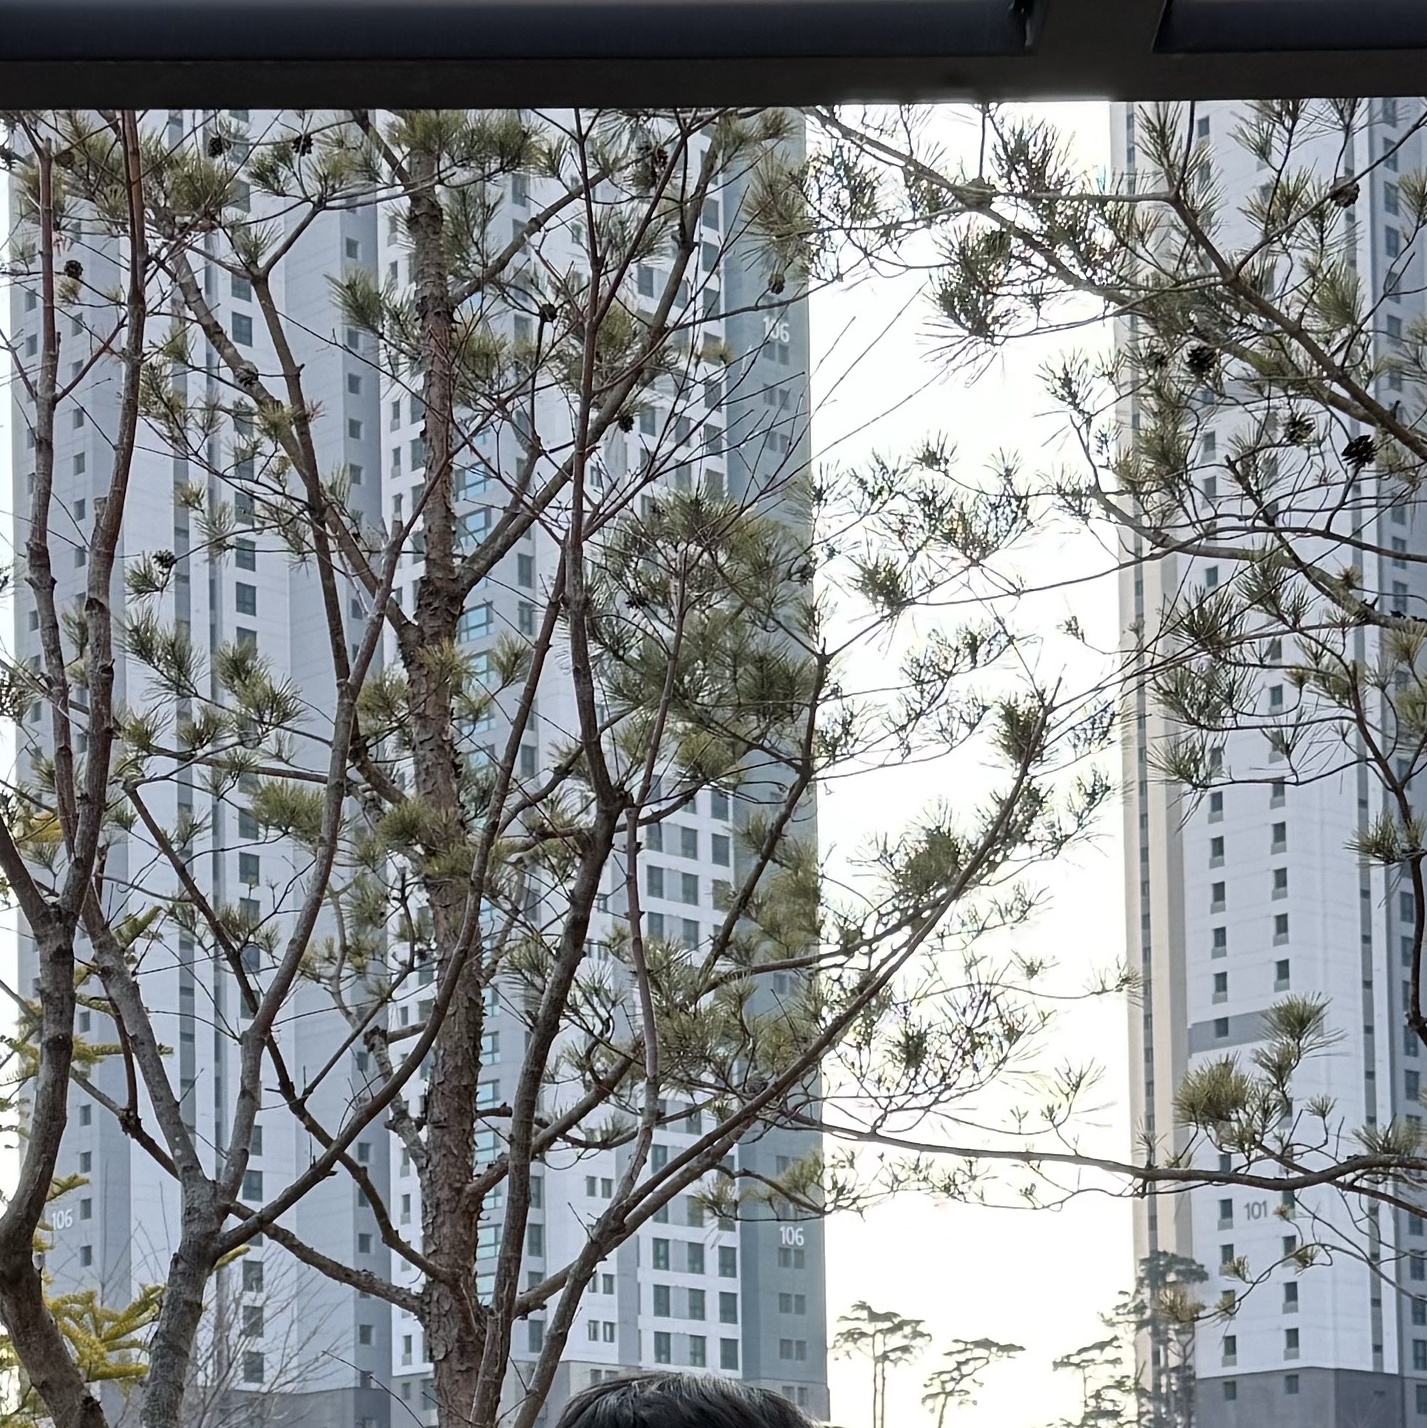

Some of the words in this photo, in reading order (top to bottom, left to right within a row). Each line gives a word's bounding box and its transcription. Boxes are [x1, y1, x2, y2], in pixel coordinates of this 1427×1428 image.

[52, 1208, 73, 1230] 106
[1244, 1200, 1267, 1220] 101
[779, 1225, 804, 1246] 106
